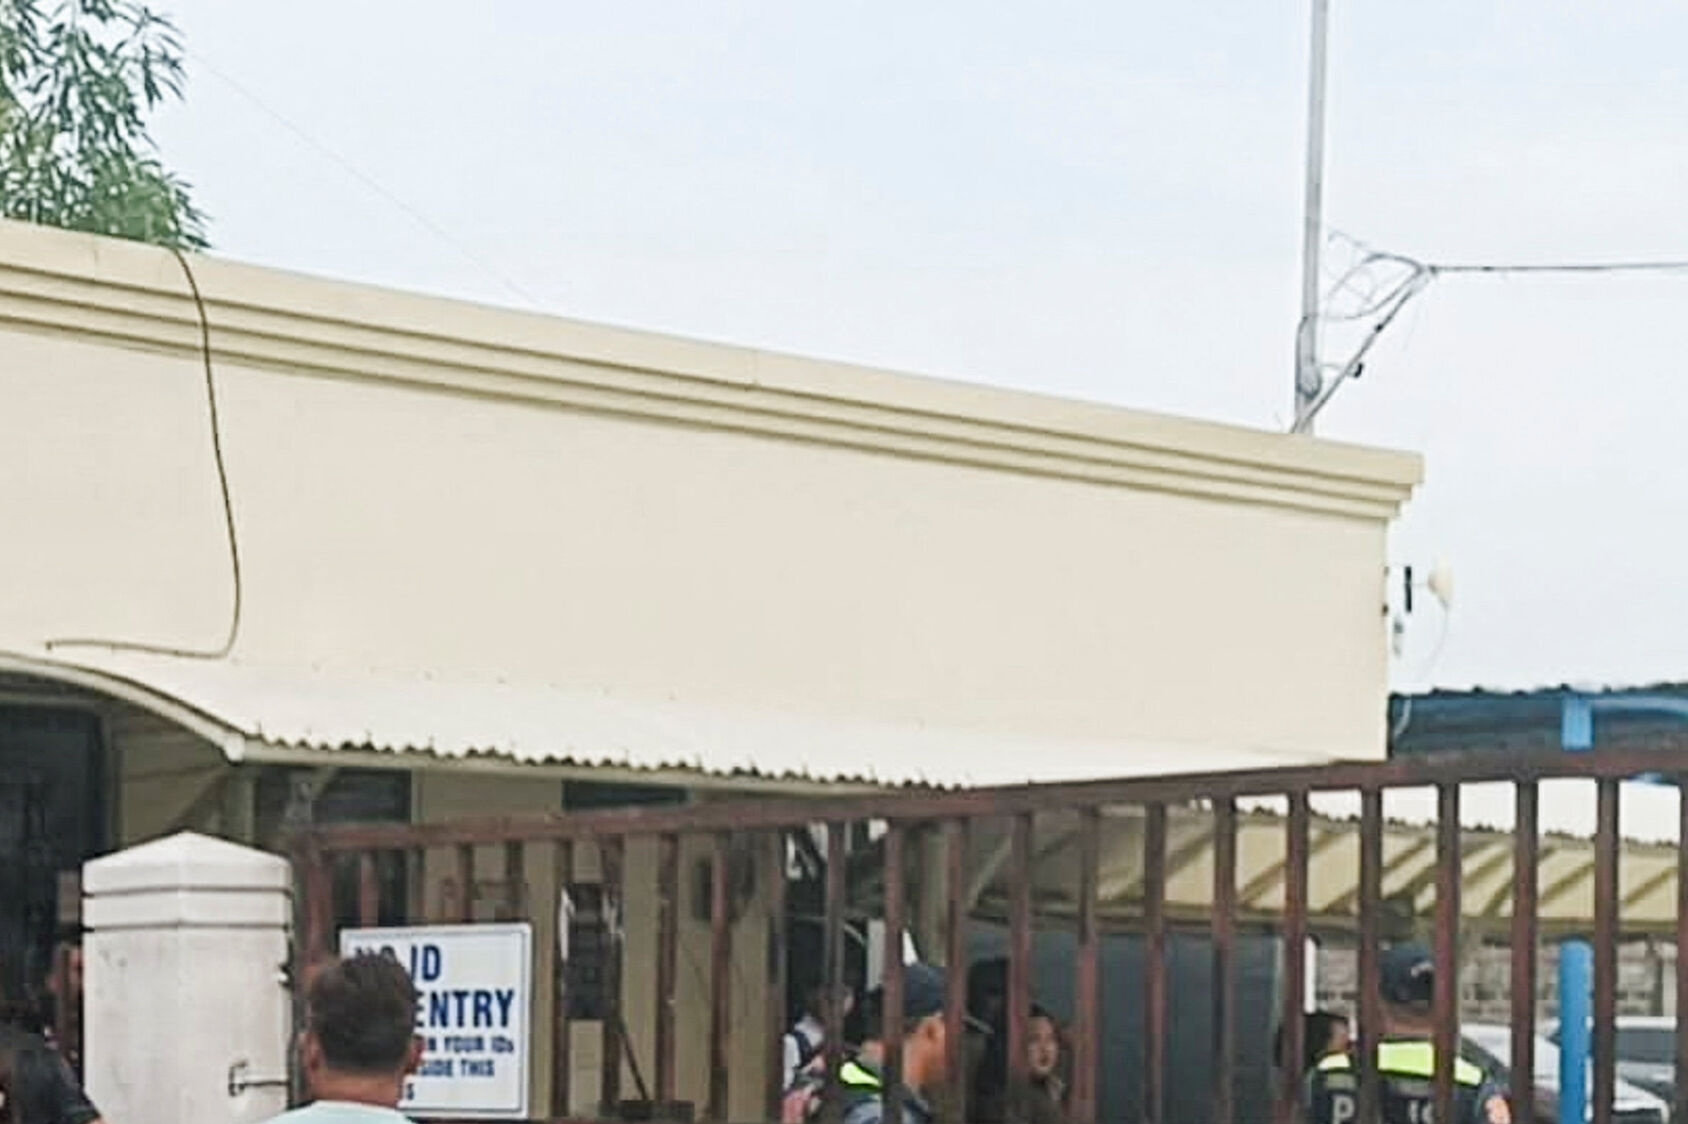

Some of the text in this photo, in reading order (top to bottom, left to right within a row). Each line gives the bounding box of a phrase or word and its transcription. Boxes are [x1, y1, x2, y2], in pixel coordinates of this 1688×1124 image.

[410, 943, 442, 982] ID
[414, 989, 515, 1029] ENTRY
[460, 1058, 495, 1078] THIS
